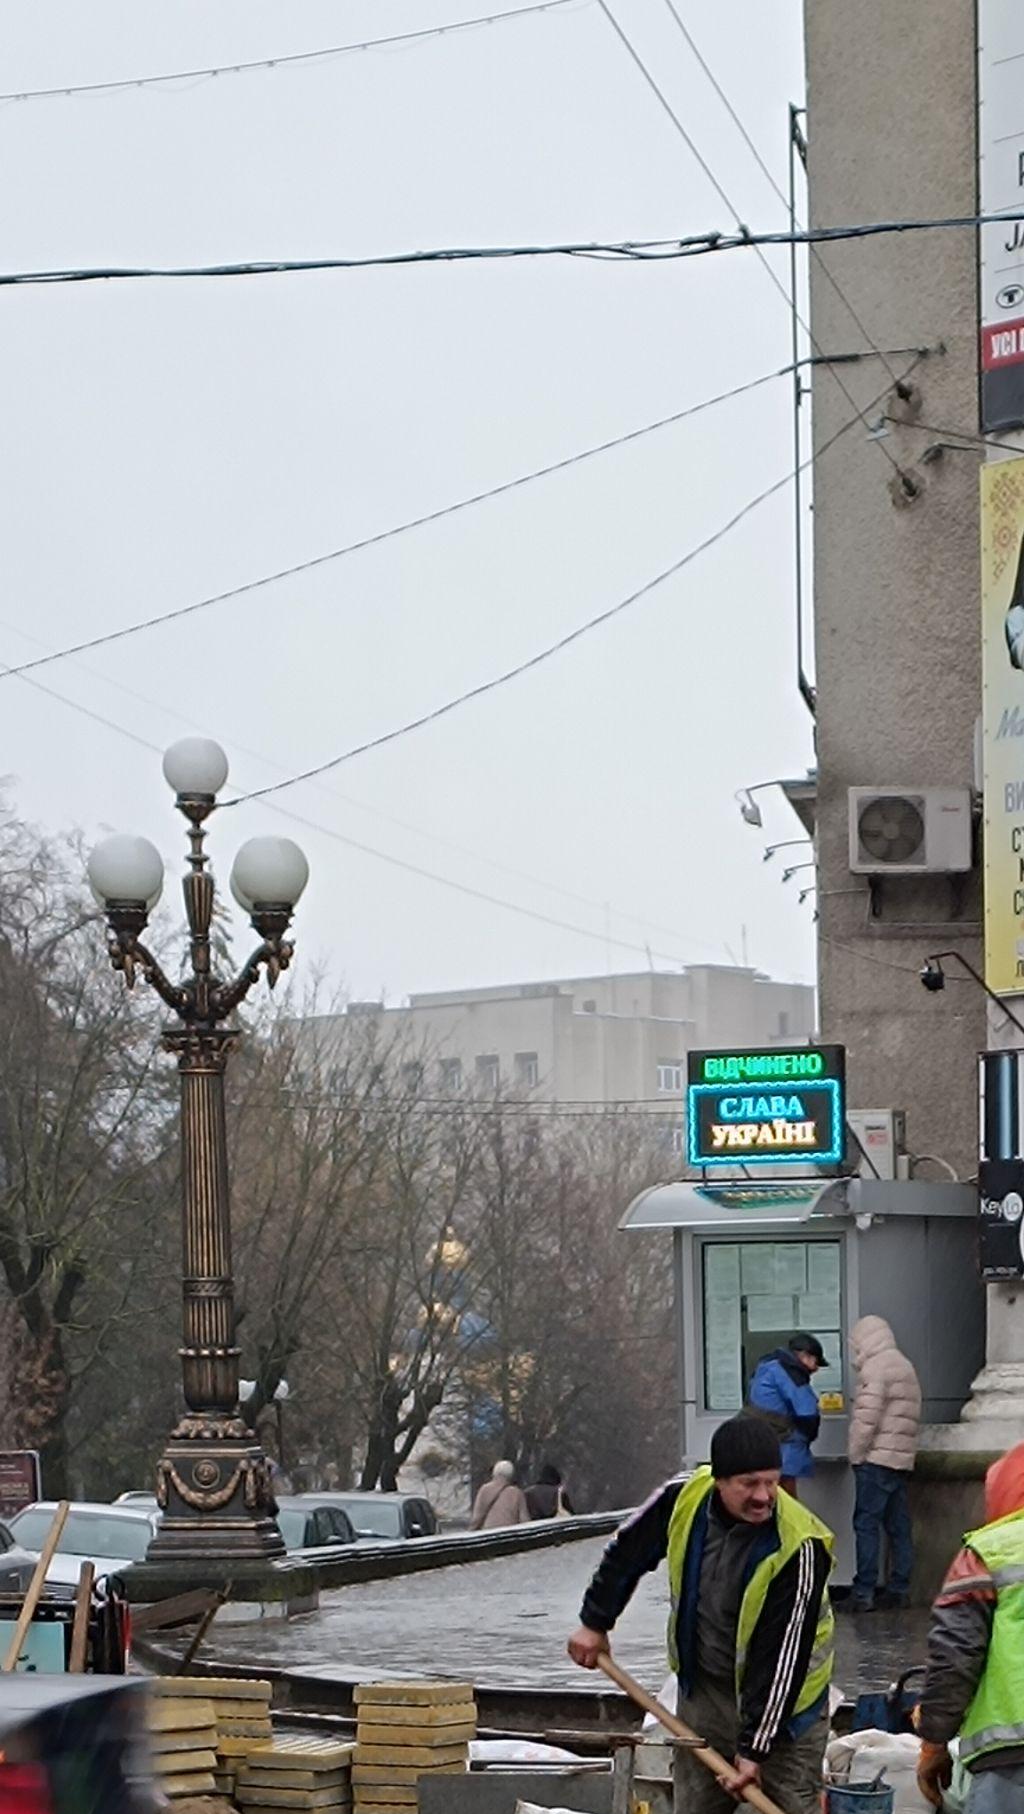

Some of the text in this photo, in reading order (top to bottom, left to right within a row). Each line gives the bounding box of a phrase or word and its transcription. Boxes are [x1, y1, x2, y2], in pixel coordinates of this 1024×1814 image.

[991, 332, 1017, 359] УСІ
[704, 1053, 823, 1079] ВІДЧИНЕНО
[719, 1095, 804, 1119] СЛАВА
[711, 1119, 817, 1147] УКРАЇНІ
